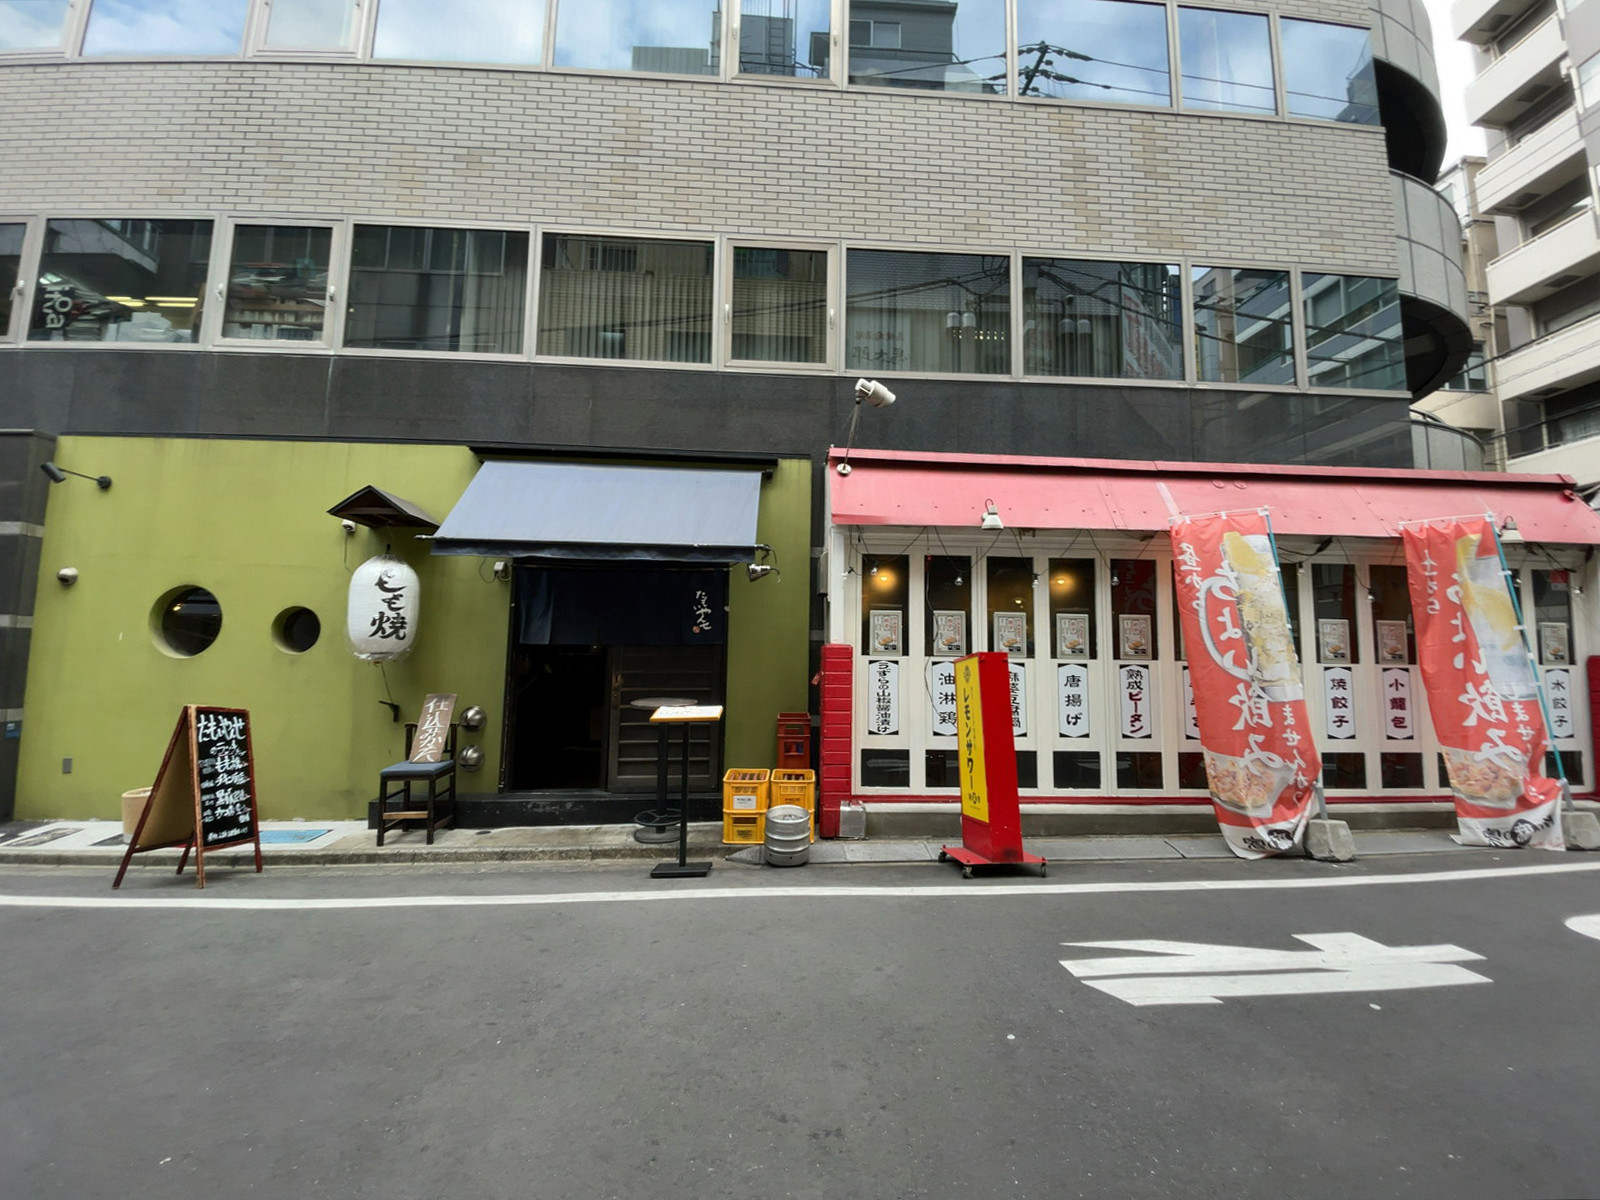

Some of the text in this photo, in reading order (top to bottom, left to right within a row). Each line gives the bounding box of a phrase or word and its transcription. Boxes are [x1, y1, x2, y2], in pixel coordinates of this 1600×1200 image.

[368, 569, 407, 640] もも焼
[876, 661, 892, 734] うずらの山椒醤油漬け
[938, 672, 956, 725] 油淋鶏
[1064, 674, 1083, 726] 唐揚げ
[1330, 678, 1349, 728] 焼餃子
[1551, 679, 1568, 728] 水餃子
[962, 686, 975, 791] レモンサワー
